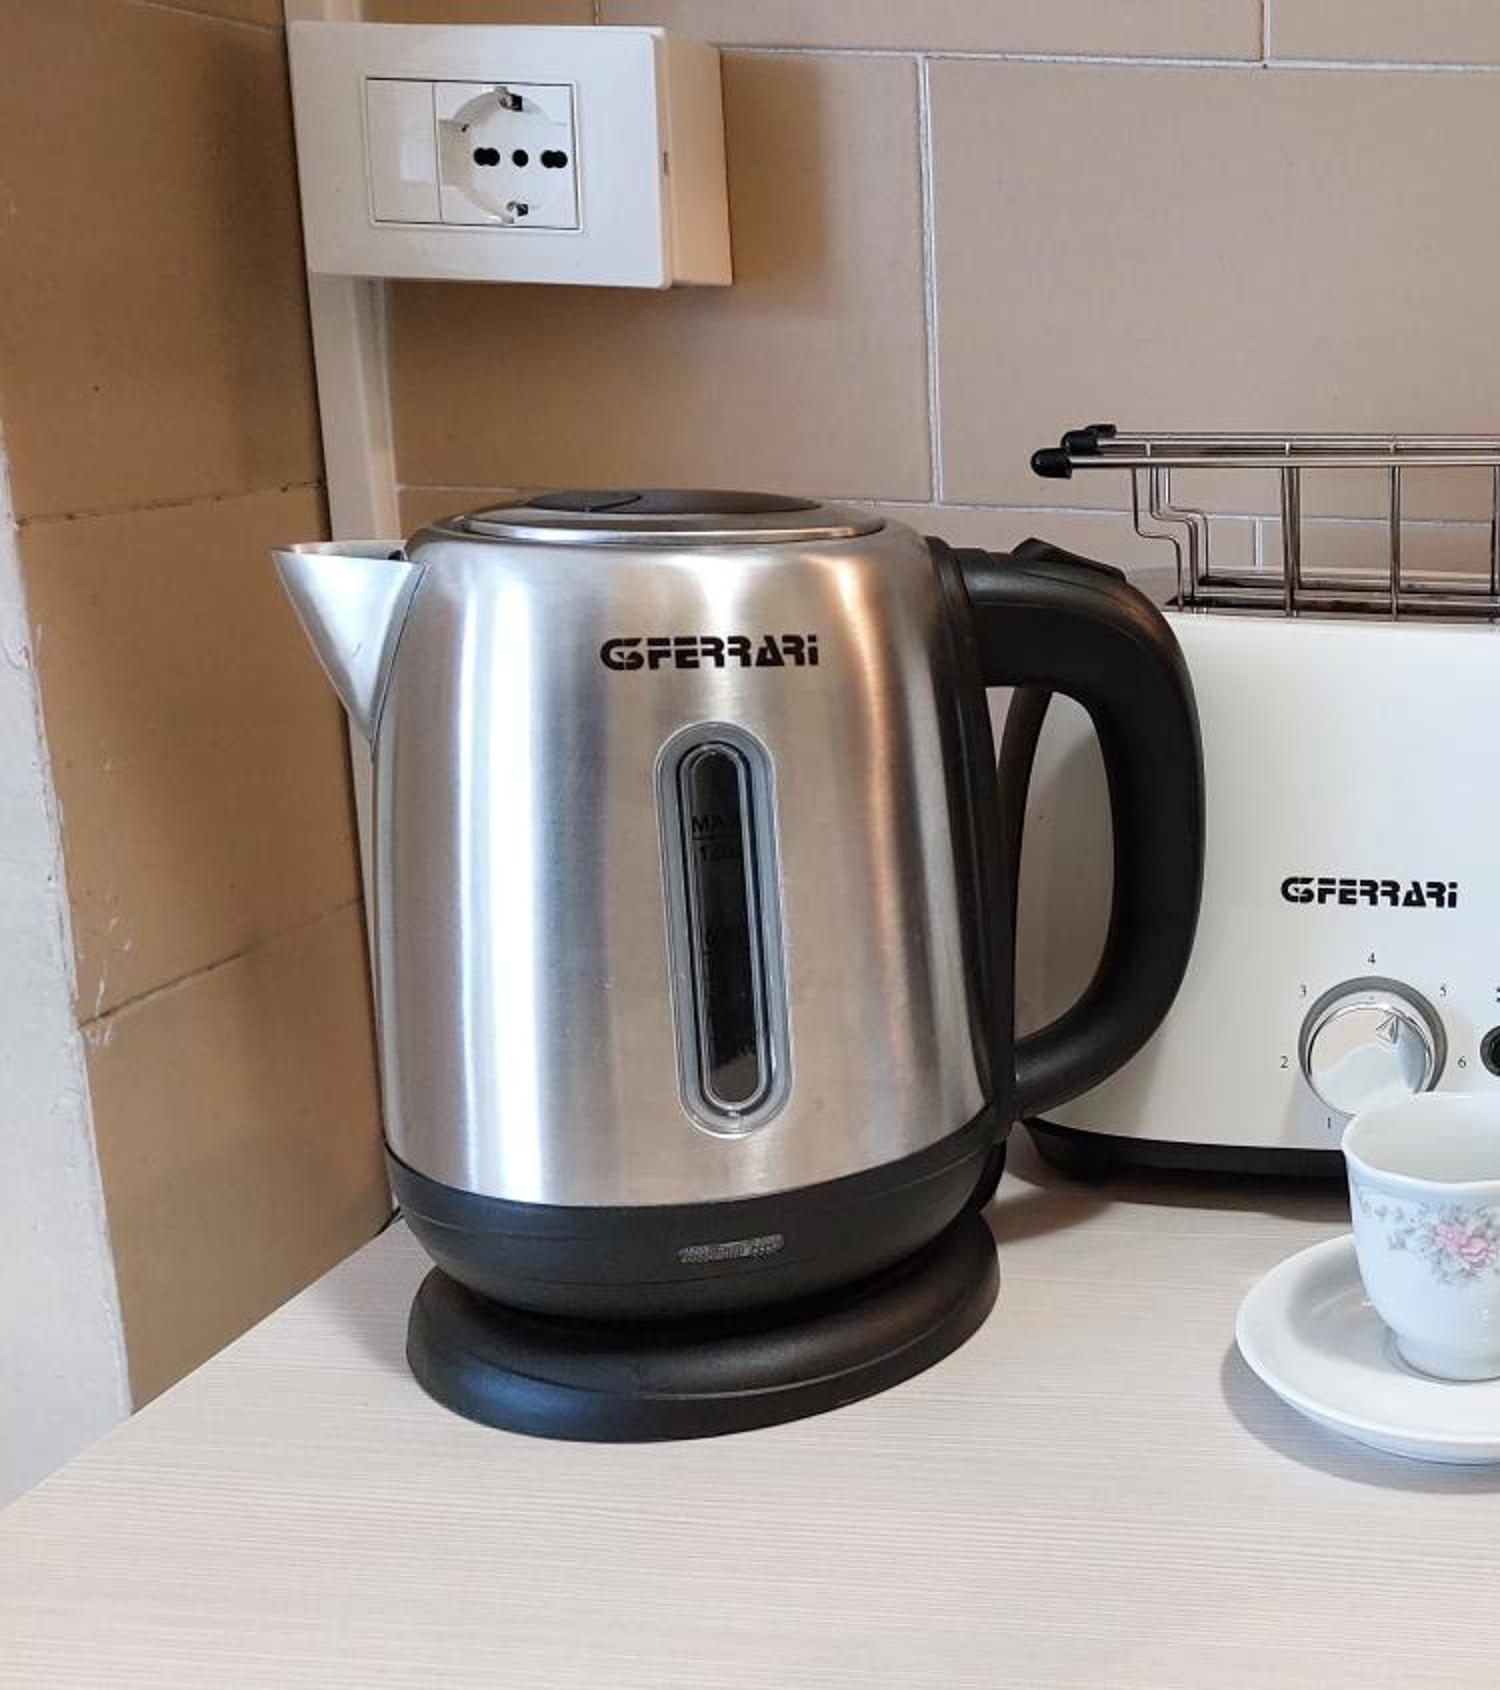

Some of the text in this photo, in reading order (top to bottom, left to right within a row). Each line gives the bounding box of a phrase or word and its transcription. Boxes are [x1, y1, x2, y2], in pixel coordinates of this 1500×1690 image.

[1367, 952, 1377, 965] 4
[1299, 984, 1307, 997] 3
[1439, 984, 1448, 997] 5
[1280, 1055, 1289, 1069] 2
[1457, 1055, 1467, 1069] 6
